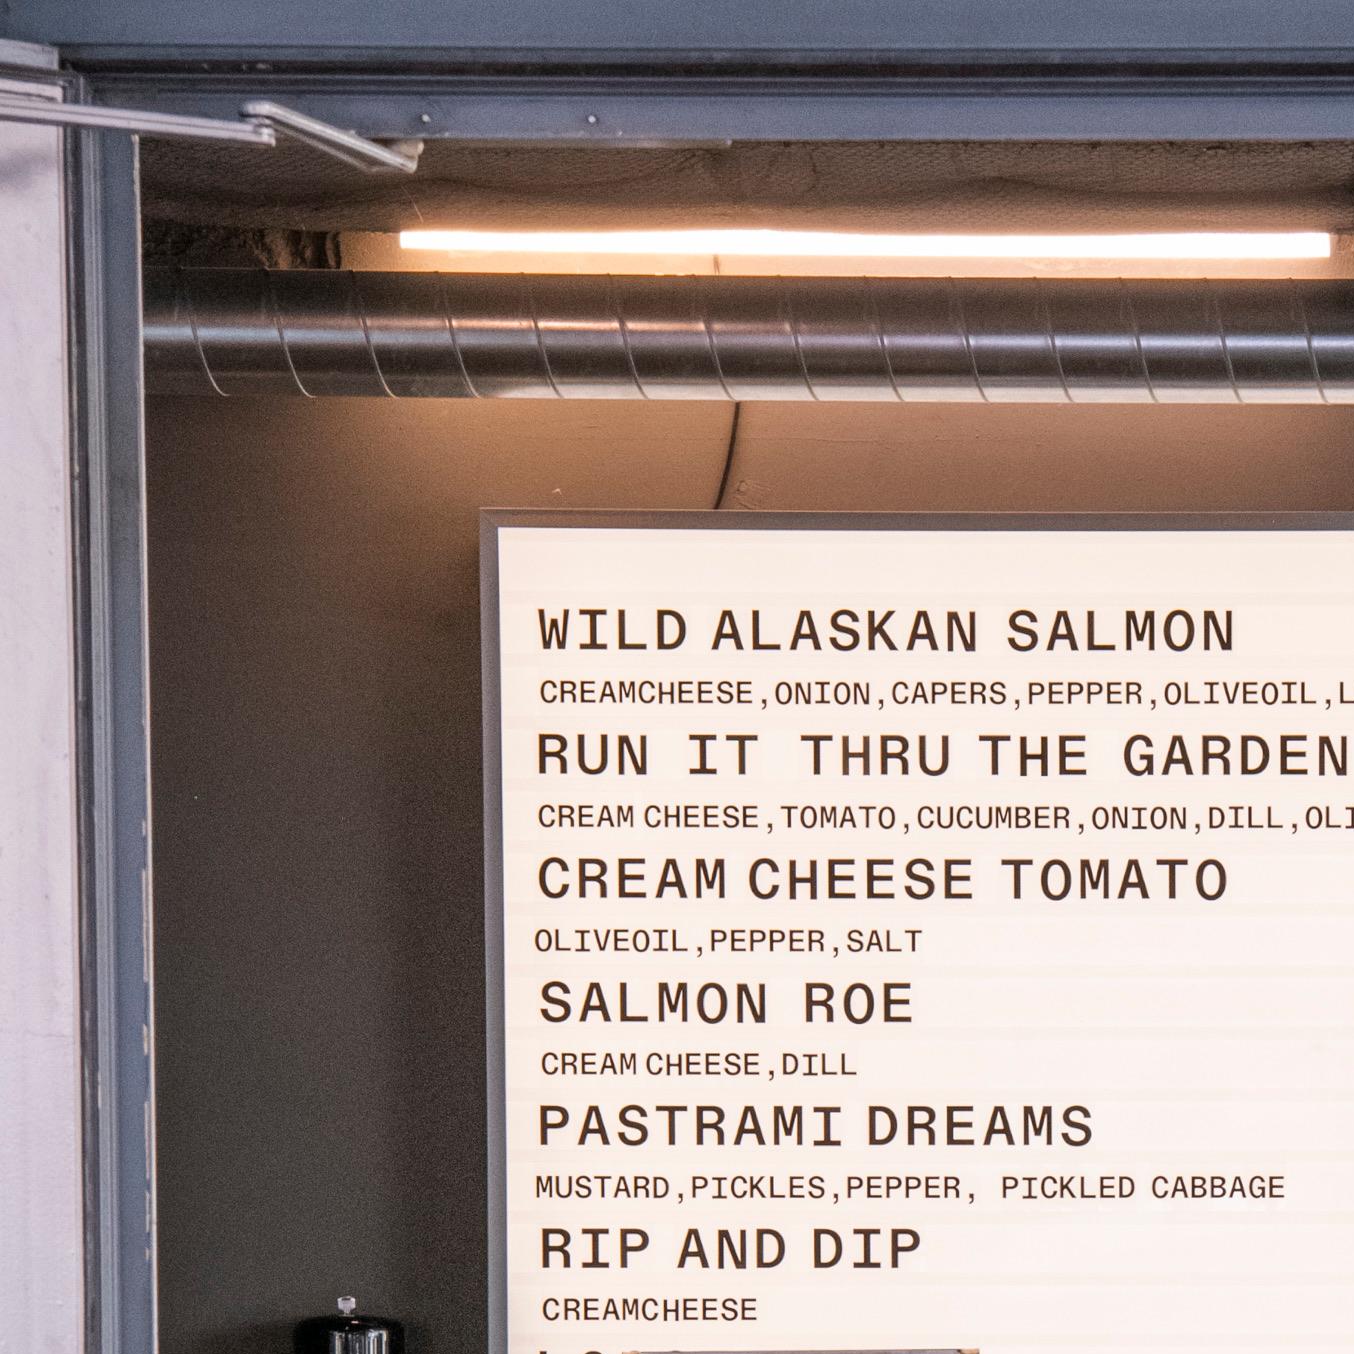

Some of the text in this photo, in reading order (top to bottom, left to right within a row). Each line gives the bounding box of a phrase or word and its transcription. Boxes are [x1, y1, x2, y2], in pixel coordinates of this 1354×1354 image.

[537, 608, 1233, 652] WILD ALASKAN SALMON
[538, 733, 1348, 777] RUN IT THRU THE GARDEN
[538, 856, 1227, 901] CREAM CHEESE TOMATO
[540, 980, 912, 1025] SALMON ROE
[540, 1104, 1092, 1147] PASTRAMI DREAMS
[1002, 1175, 1135, 1200] PICKLED
[1151, 1175, 1285, 1199] CABBAGE
[541, 1228, 921, 1270] RIP AND DIP
[542, 1297, 757, 1322] CREAMCHEESE
